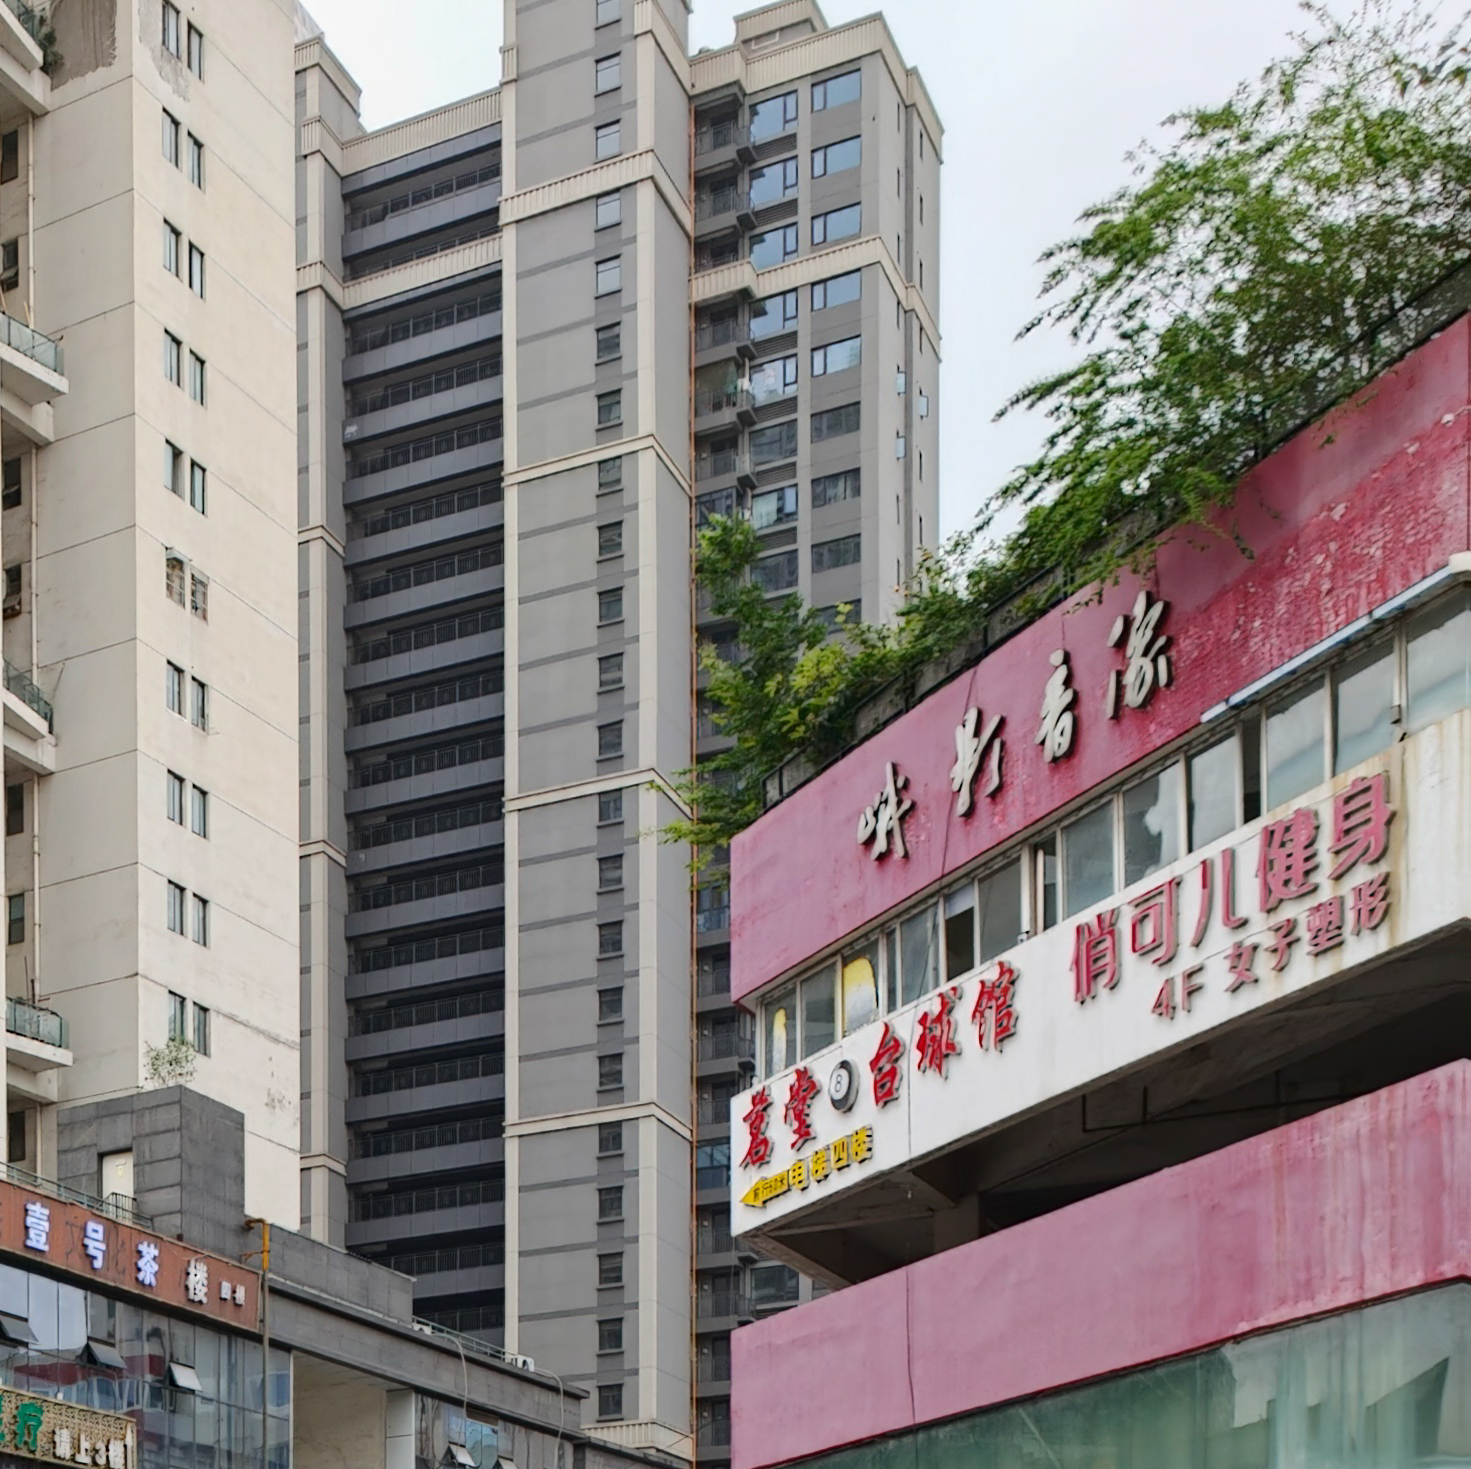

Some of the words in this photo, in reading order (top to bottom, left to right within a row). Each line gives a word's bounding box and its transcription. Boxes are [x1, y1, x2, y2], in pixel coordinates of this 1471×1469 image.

[1071, 770, 1395, 1004] 俏可儿健身
[1151, 966, 1206, 1022] 4F
[1226, 871, 1392, 996] 女子塑形
[869, 962, 1021, 1107] 台球馆
